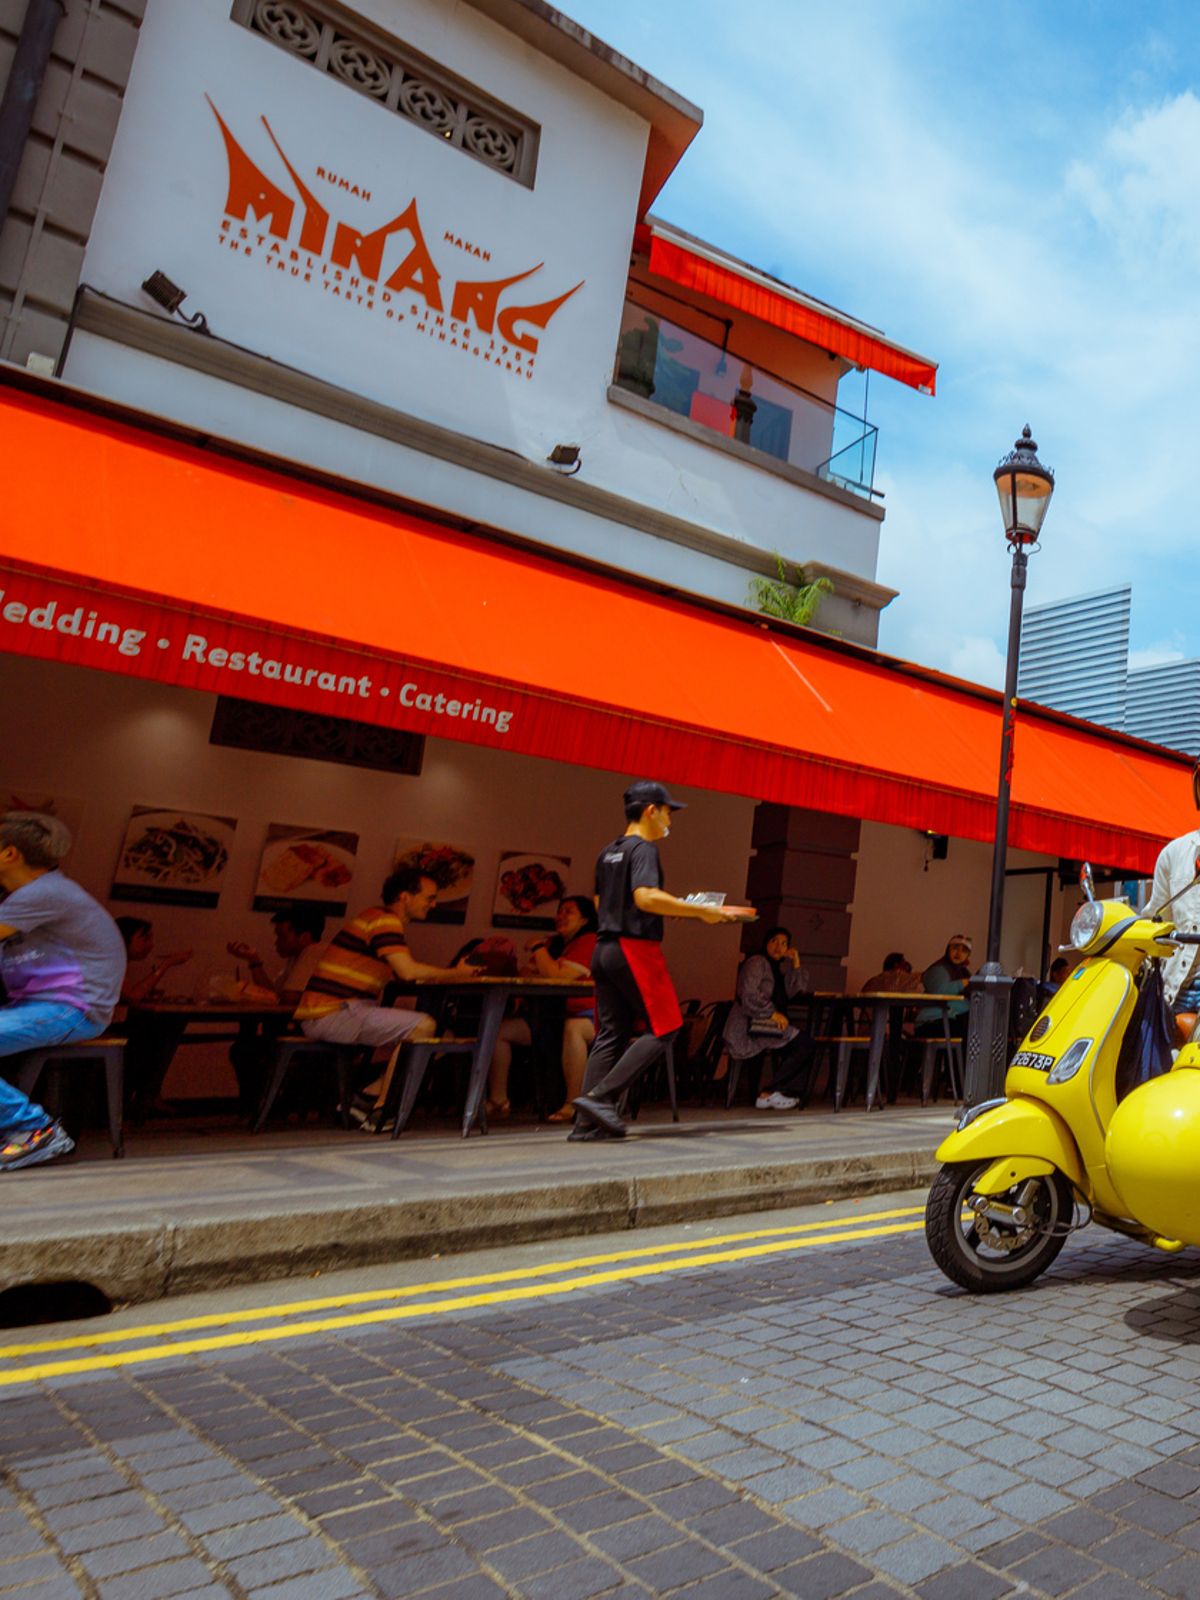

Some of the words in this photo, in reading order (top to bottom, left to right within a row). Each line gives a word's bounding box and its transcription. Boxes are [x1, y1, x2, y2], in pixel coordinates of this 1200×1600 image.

[316, 166, 372, 201] RUMAH
[444, 231, 491, 262] MAKAN
[218, 234, 253, 257] THE
[266, 254, 312, 283] TRUE
[323, 280, 374, 310] TASTE
[385, 308, 405, 323] OF
[416, 321, 533, 380] MINANGKABAU
[221, 218, 392, 302] ESTABLISHED
[410, 304, 471, 338] SINCE
[489, 338, 535, 368] 1984
[0, 590, 146, 656] edding
[182, 633, 373, 698] Restaurant
[399, 683, 514, 733] Catering
